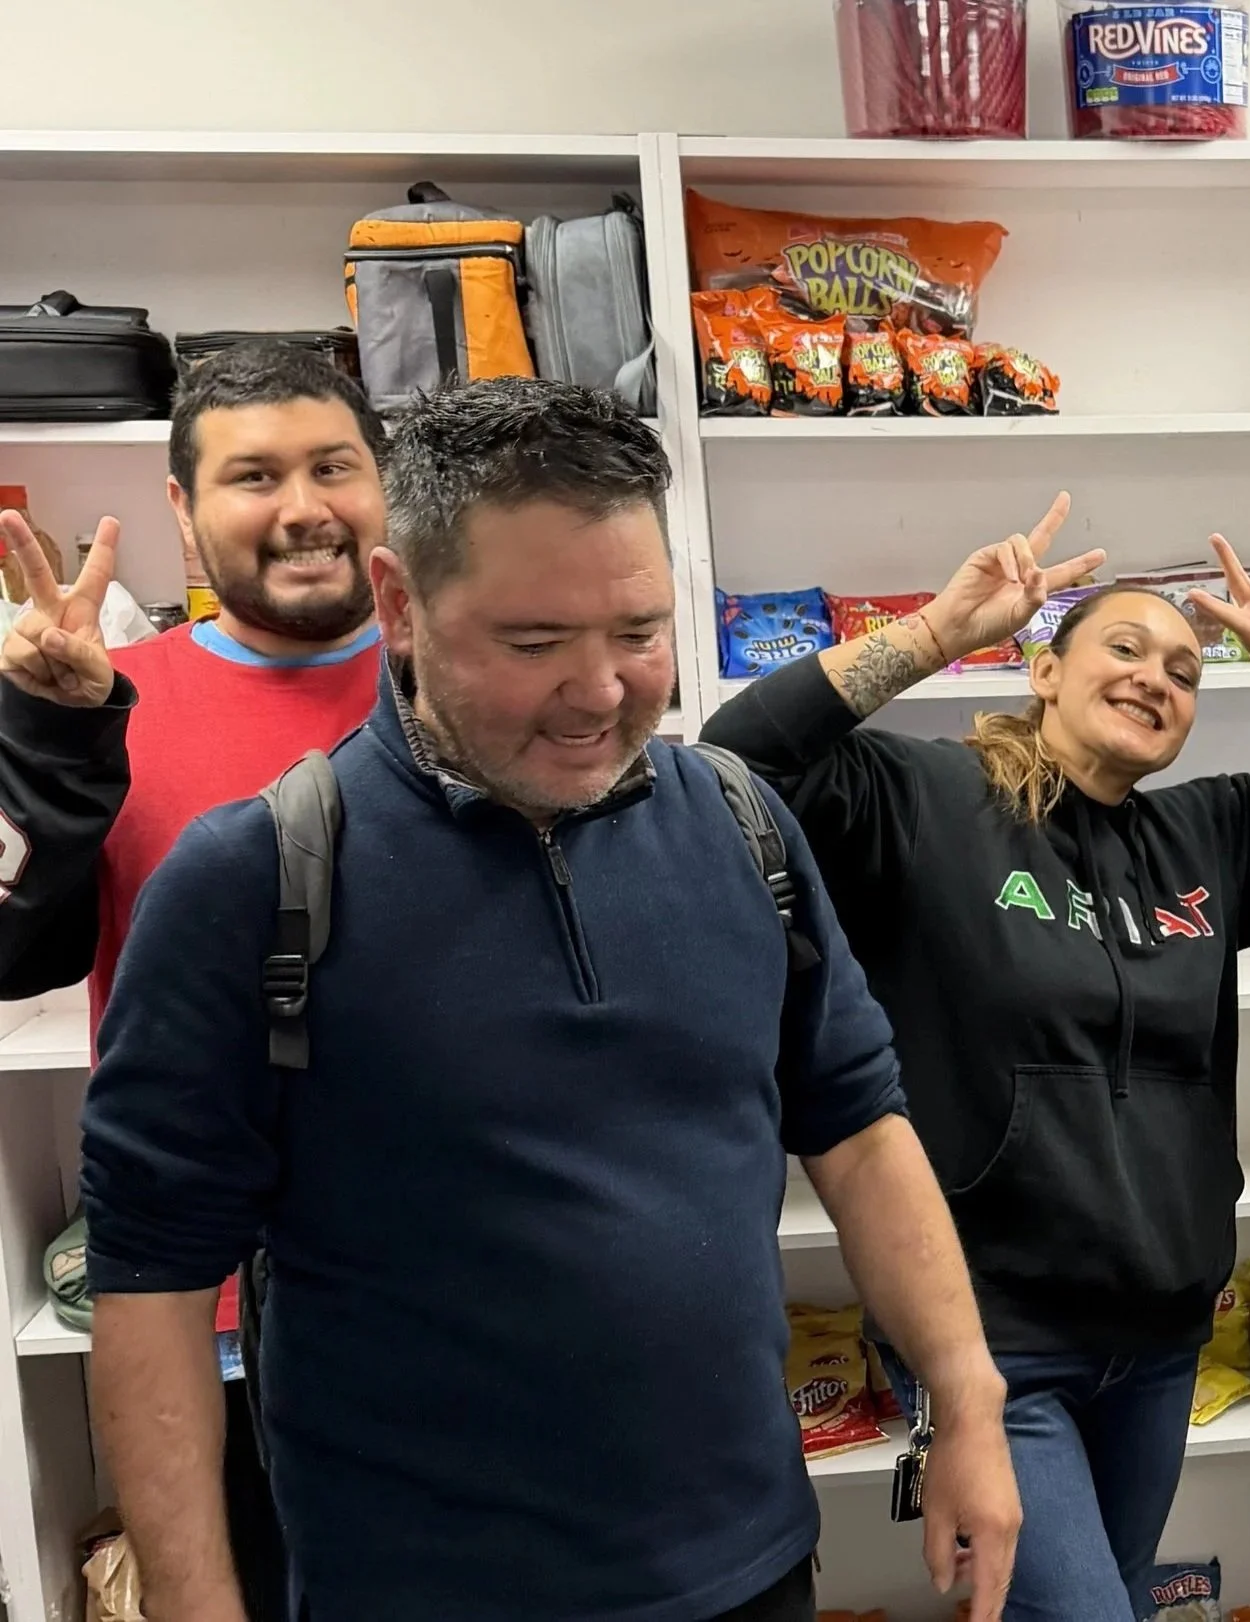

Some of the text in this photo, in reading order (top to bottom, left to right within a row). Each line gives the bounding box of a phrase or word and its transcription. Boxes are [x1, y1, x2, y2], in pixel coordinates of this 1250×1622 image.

[786, 239, 919, 295] POPCORN
[746, 642, 814, 661] OREO
[753, 636, 795, 651] mini
[791, 1379, 848, 1416] Fritos
[1151, 1575, 1212, 1605] RUFFLES
